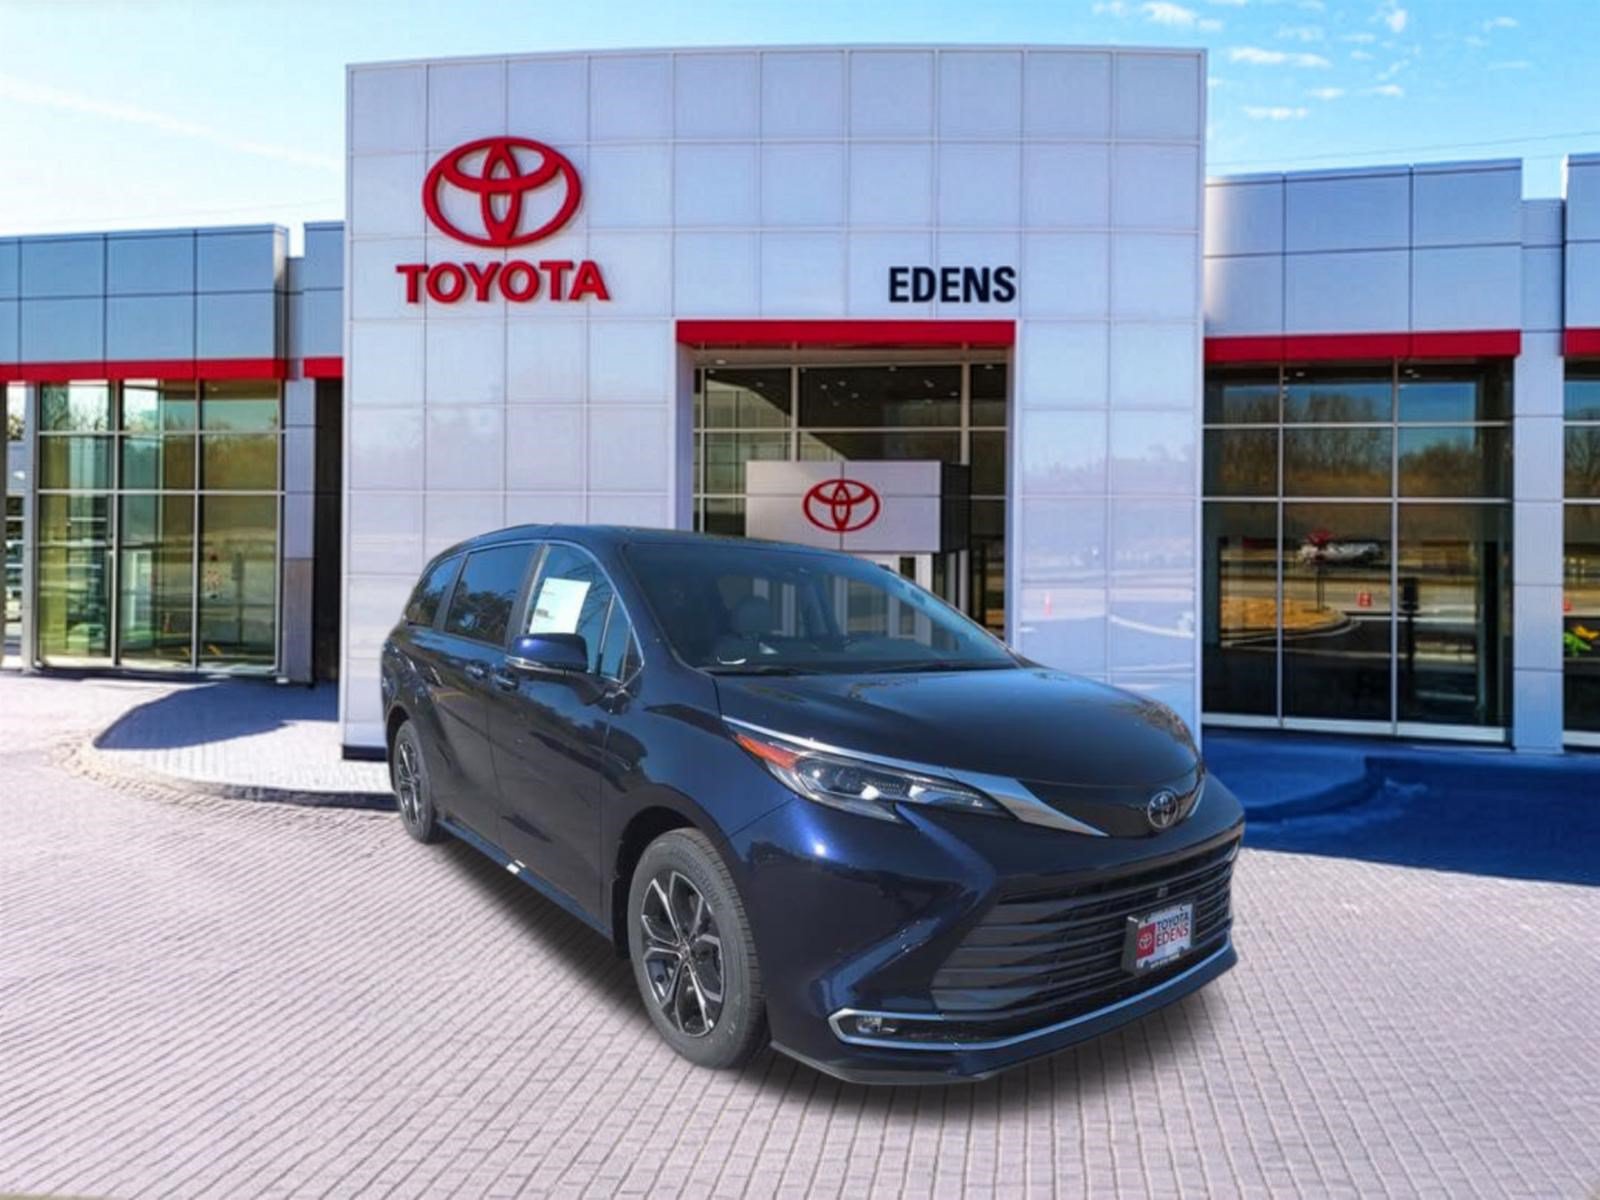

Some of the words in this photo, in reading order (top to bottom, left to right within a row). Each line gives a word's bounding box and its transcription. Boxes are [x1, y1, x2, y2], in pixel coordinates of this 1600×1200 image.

[396, 260, 611, 304] TOYOTA
[889, 266, 1016, 303] EDENS
[1156, 922, 1189, 947] EDENS
[1157, 911, 1189, 931] TOYOTA
